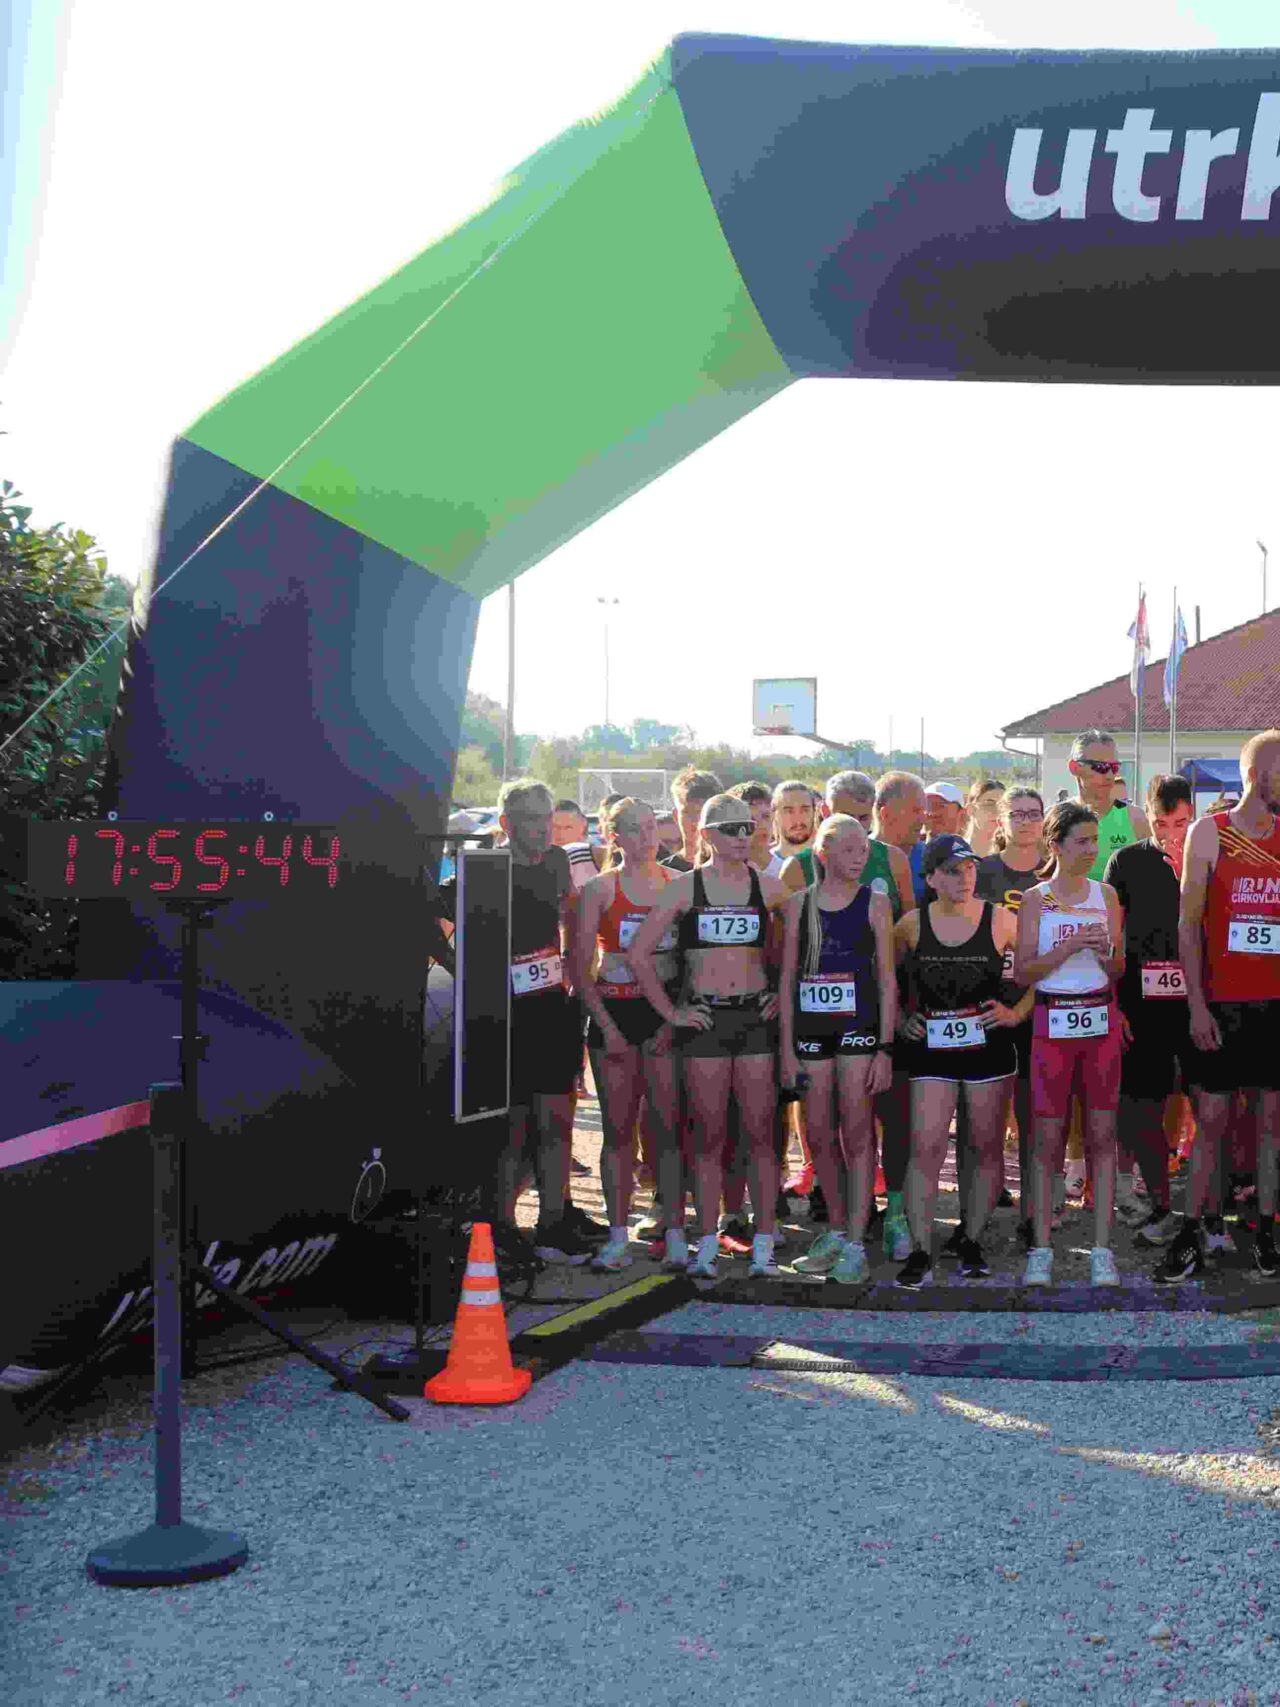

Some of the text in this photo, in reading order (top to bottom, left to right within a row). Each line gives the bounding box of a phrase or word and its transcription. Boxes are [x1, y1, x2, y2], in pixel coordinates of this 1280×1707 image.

[65, 829, 341, 891] 17:55:44
[711, 917, 748, 935] 173
[1246, 926, 1271, 945] 85
[528, 962, 550, 982] 95
[1157, 971, 1182, 988] 46
[808, 986, 843, 1004] 109
[1067, 1011, 1092, 1029] 96
[942, 1021, 968, 1039] 49
[798, 1035, 876, 1053] KE PRO
